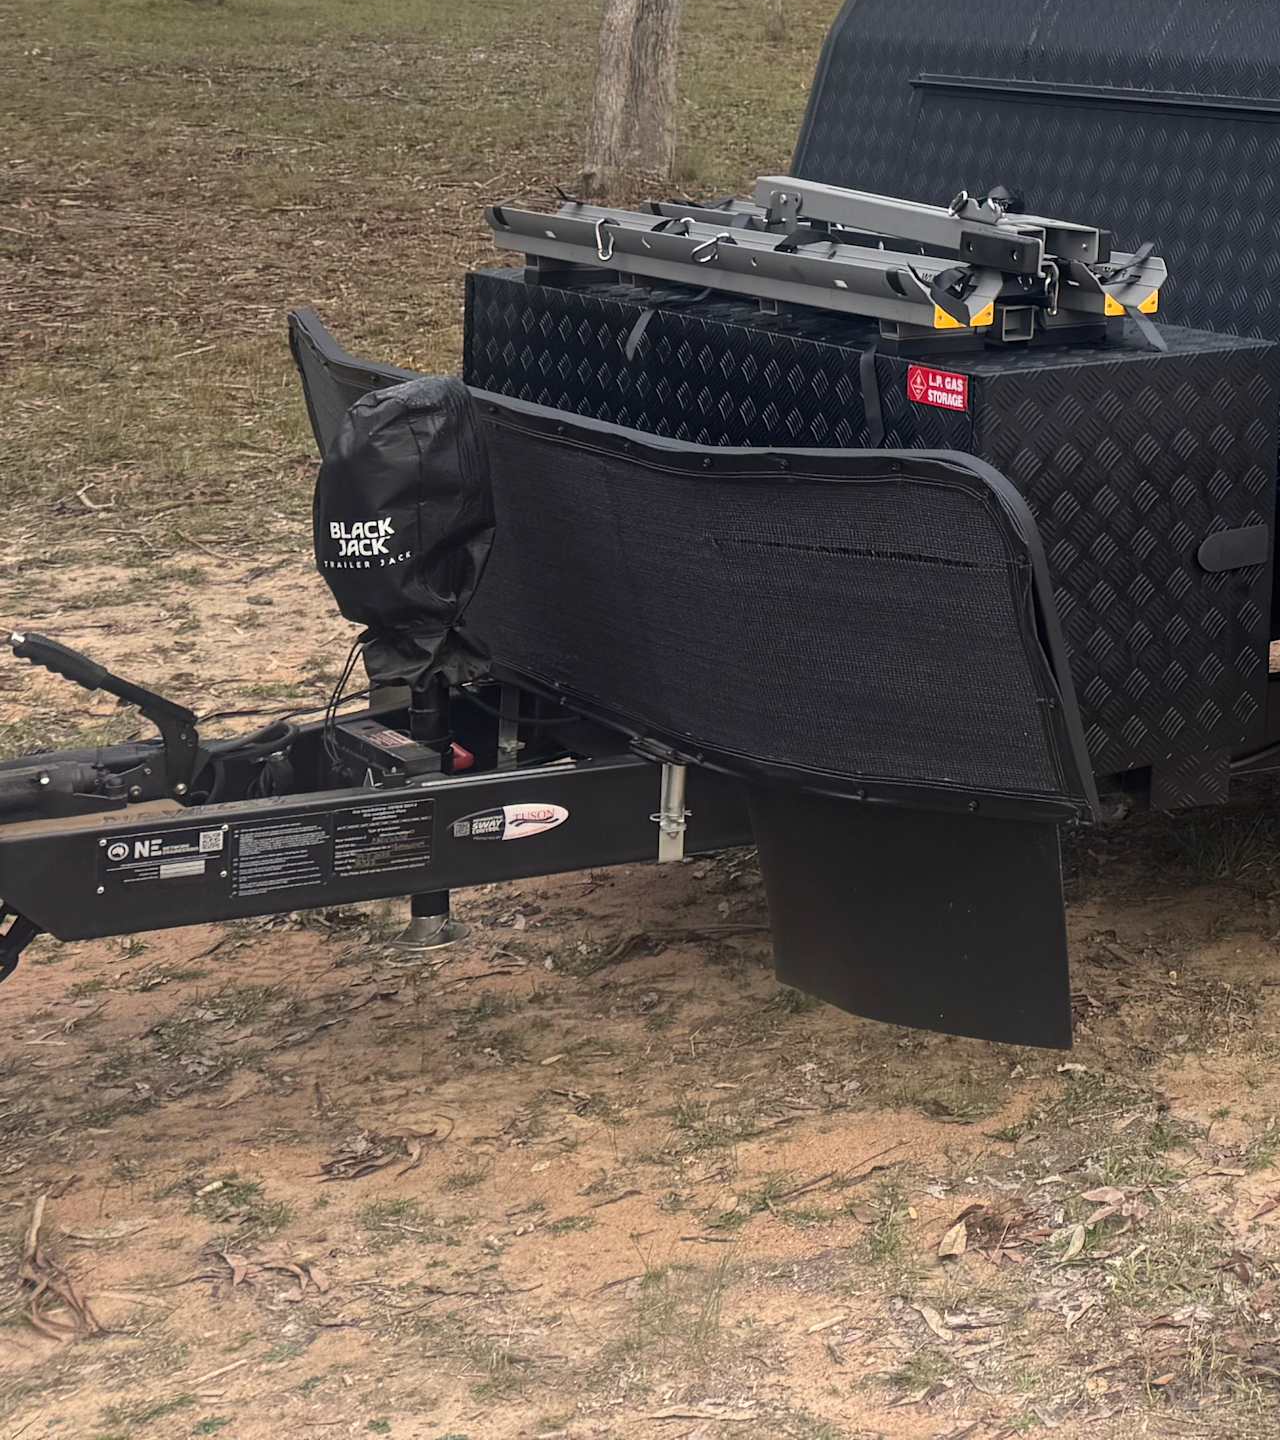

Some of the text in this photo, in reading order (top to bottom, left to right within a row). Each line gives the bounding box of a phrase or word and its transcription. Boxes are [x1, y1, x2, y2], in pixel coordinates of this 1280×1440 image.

[944, 377, 964, 392] GAS
[927, 389, 964, 408] STORAGE
[329, 516, 395, 539] BLACK
[338, 535, 390, 556] JACK
[323, 550, 412, 569] TRAILER JACK
